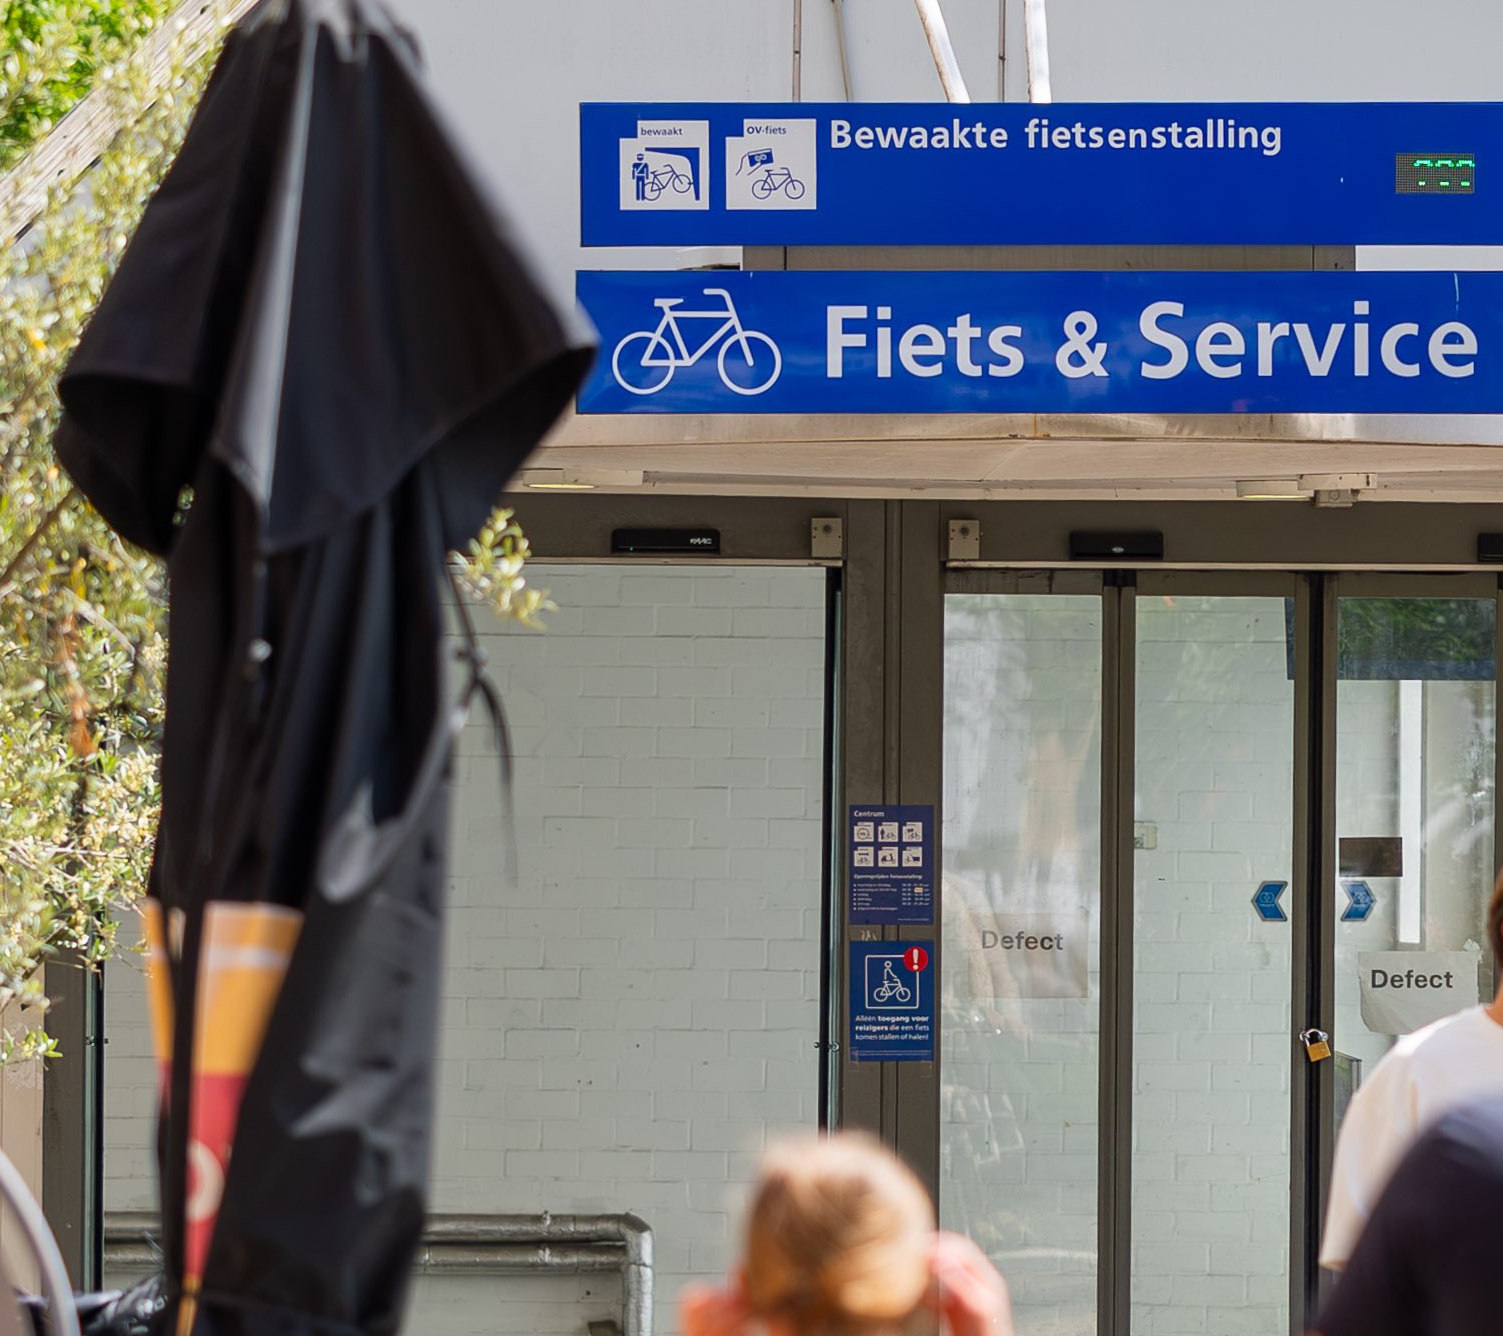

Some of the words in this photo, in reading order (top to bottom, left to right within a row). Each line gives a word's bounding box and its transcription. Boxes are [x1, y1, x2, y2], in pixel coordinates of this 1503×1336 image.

[640, 126, 684, 137] bewaakt
[746, 125, 788, 136] OV-fiets
[830, 118, 1009, 150] Bewaakte
[1025, 116, 1283, 156] fietsenstalling
[826, 304, 1024, 380] Fiets
[1054, 310, 1110, 380] &
[1138, 299, 1480, 381] Service
[853, 810, 885, 818] Centrum
[981, 930, 1064, 951] Defect
[1371, 969, 1453, 989] Defect
[855, 1024, 889, 1032] reizigers
[879, 1033, 899, 1041] stallen
[908, 1033, 929, 1041] halen!
